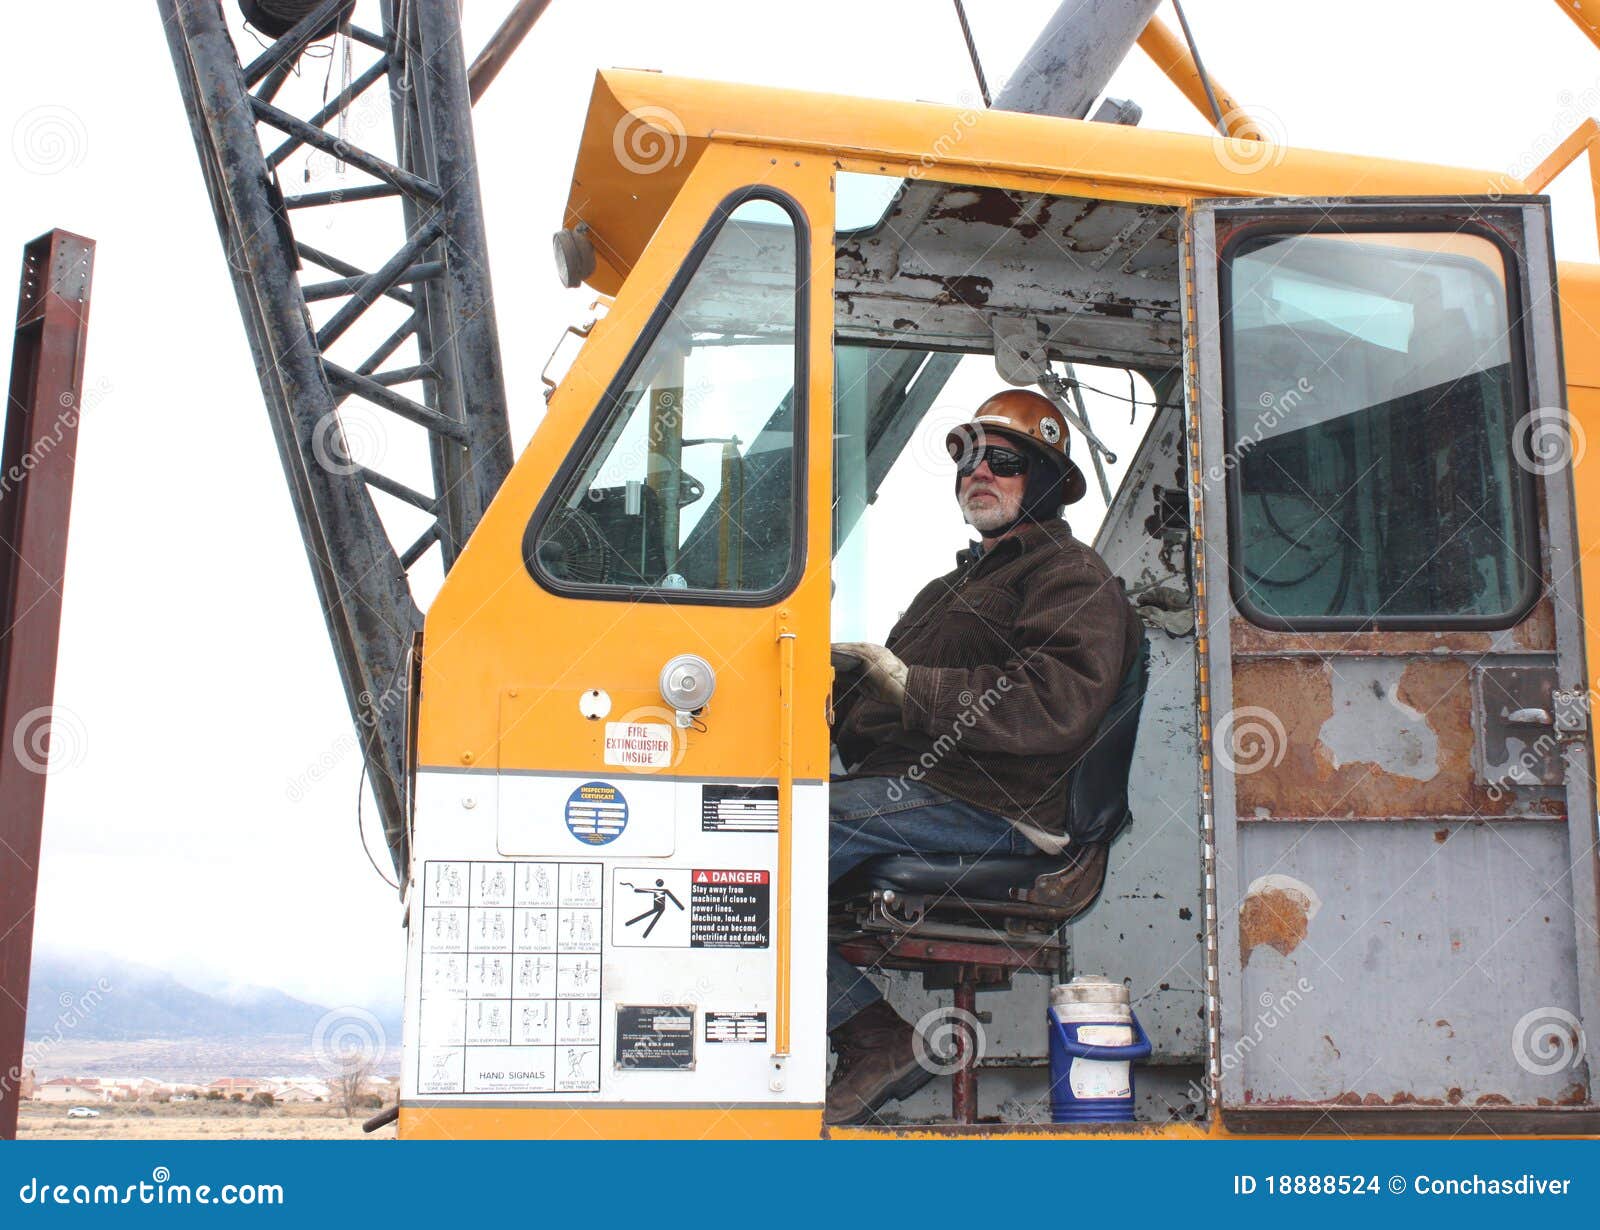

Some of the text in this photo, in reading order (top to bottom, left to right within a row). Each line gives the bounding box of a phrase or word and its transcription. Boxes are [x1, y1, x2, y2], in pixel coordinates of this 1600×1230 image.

[628, 727, 648, 737] FIRE
[606, 738, 669, 752] EXTINGUISHER
[622, 752, 653, 763] INSIDE
[712, 872, 761, 883] DANGER
[692, 885, 707, 894] Stay
[709, 887, 727, 895] away
[692, 895, 720, 903] machine
[722, 895, 728, 903] if
[729, 895, 747, 903] close
[692, 904, 734, 913] power lines.
[692, 914, 756, 923] Machine, load, and
[691, 924, 715, 933] ground
[731, 924, 757, 932] become
[691, 933, 768, 943] electrified and deadly.
[480, 1071, 545, 1079] HAND SIGNALS
